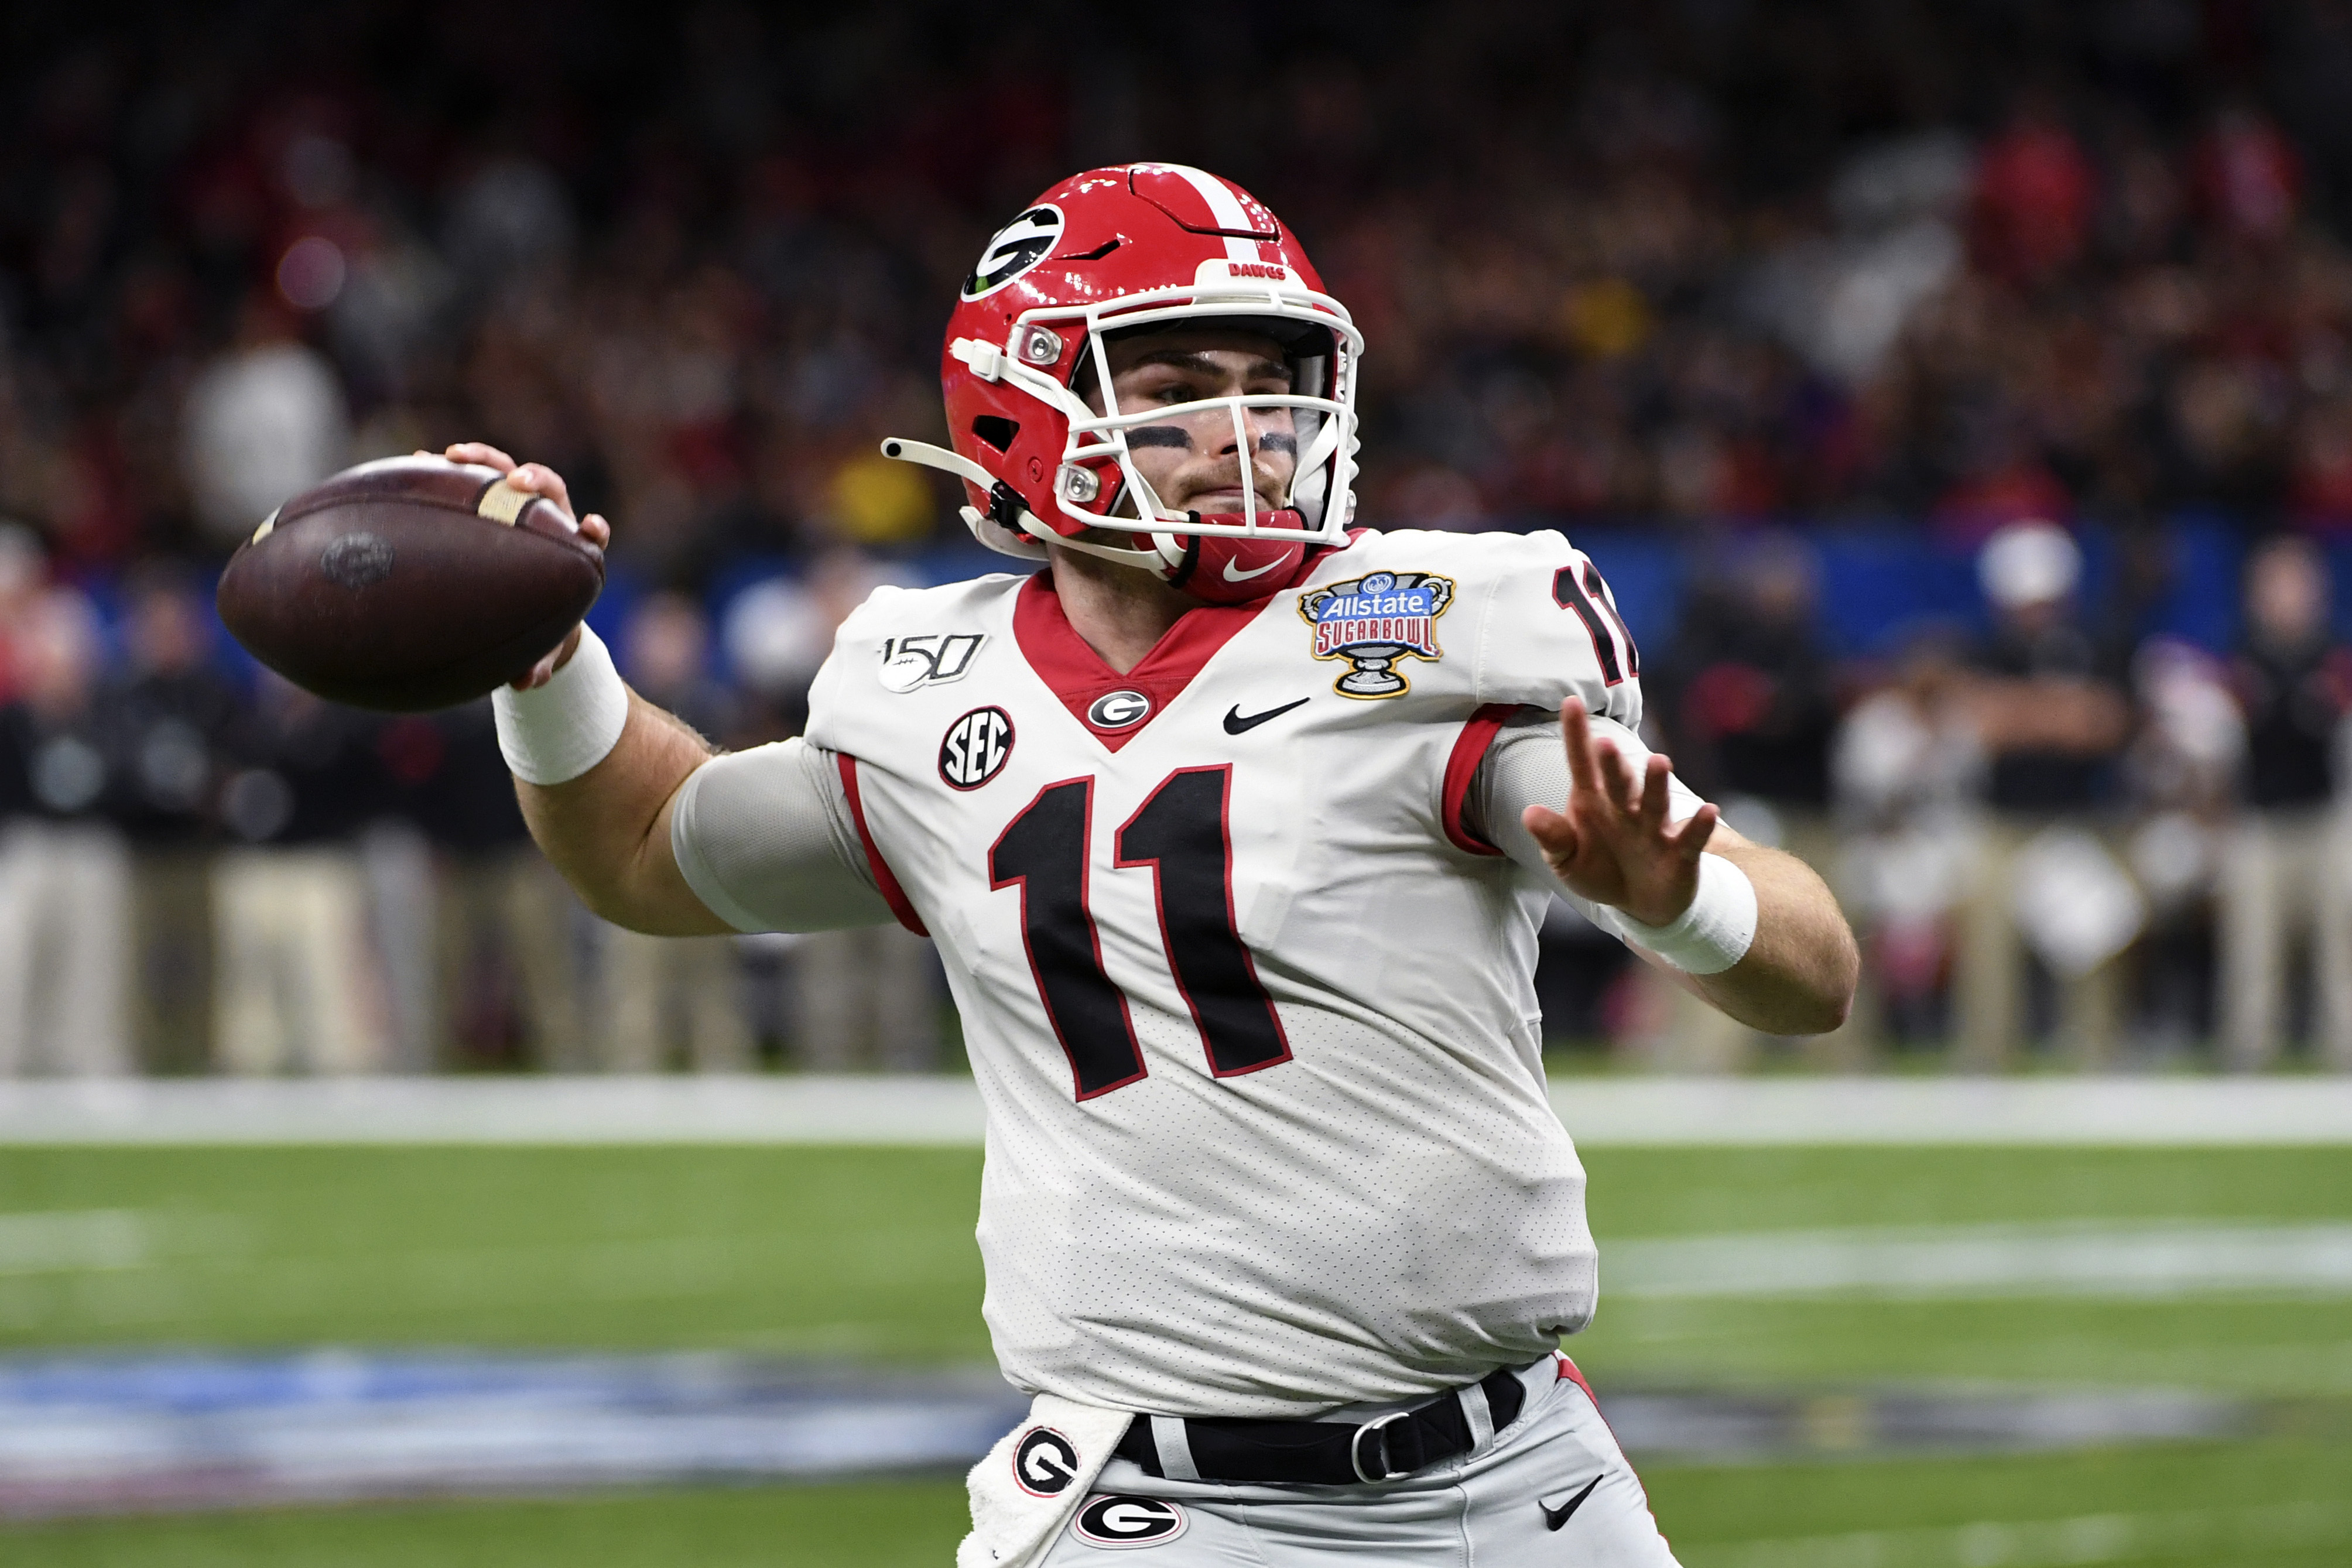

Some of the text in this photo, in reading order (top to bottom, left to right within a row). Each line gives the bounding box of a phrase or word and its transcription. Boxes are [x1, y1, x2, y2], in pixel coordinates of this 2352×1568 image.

[1228, 263, 1286, 280] DAWGS
[1322, 592, 1424, 618] Allstate
[881, 634, 985, 687] 150
[1089, 691, 1148, 727] G
[944, 710, 1008, 783] SEC
[987, 762, 1293, 1103] 11
[1016, 1429, 1079, 1494] G
[1079, 1495, 1178, 1541] G
